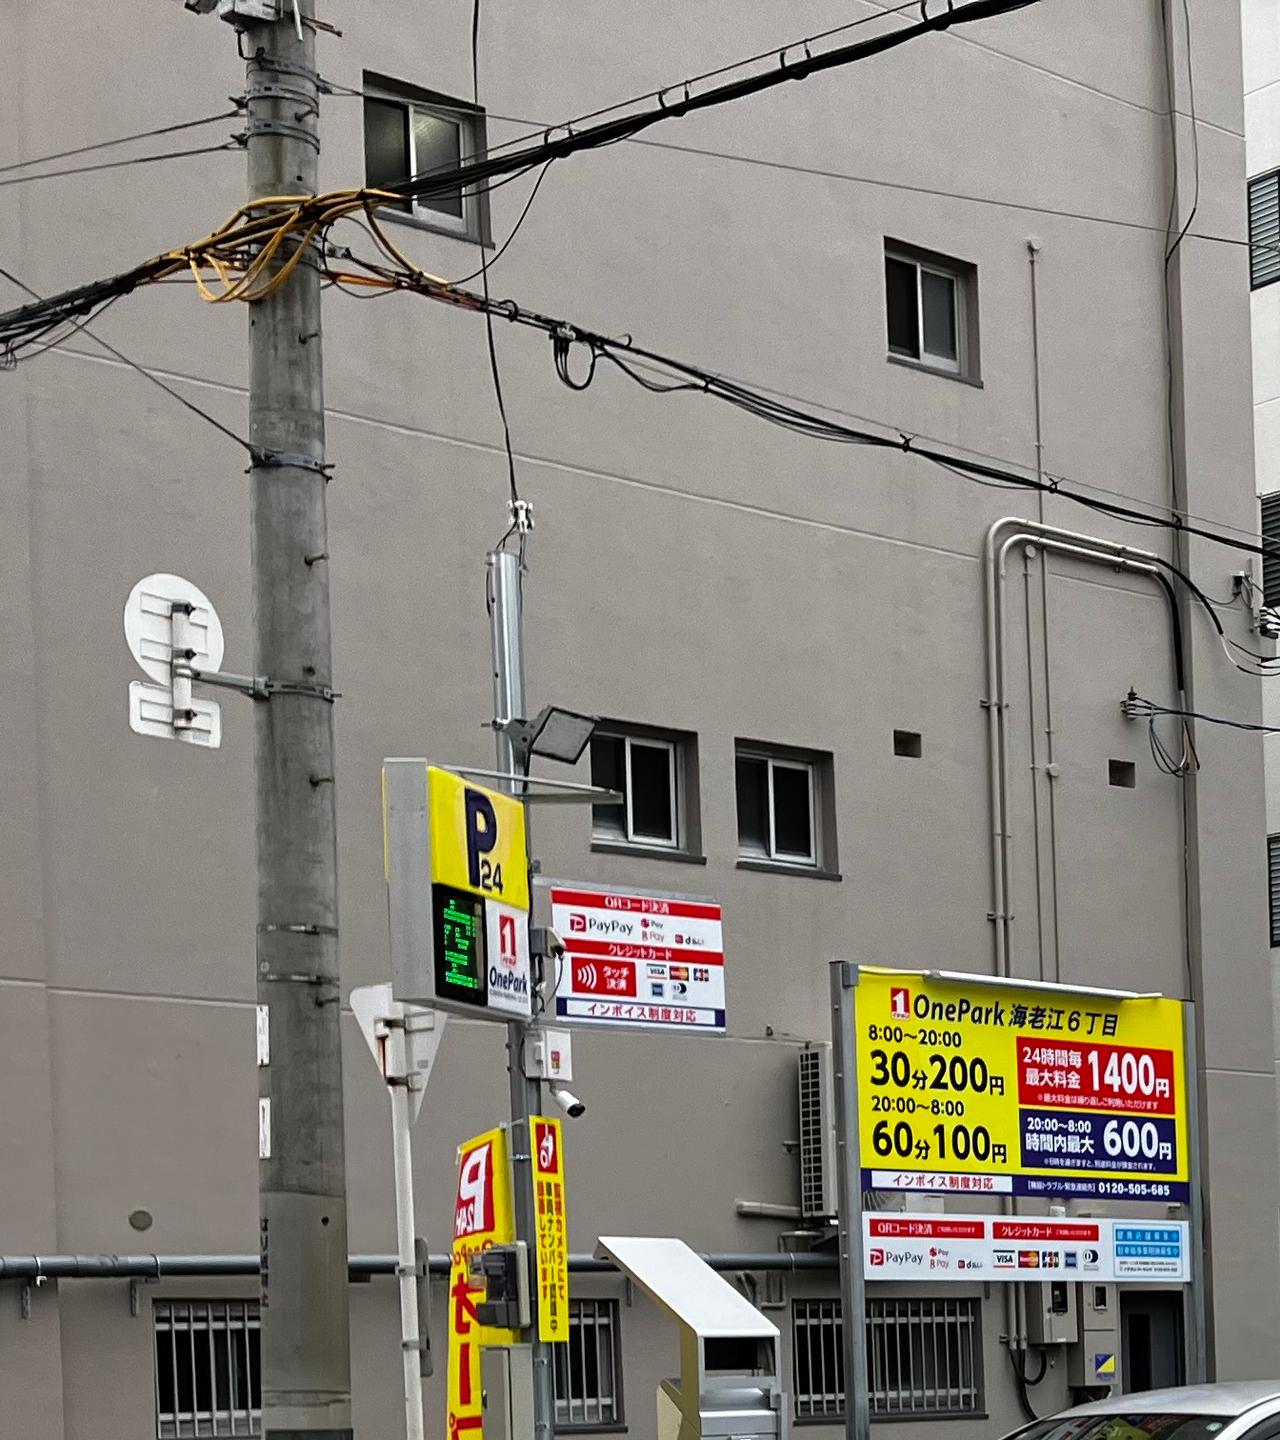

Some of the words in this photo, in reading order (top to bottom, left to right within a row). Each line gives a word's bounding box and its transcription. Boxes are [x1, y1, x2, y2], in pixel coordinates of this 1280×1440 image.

[465, 787, 498, 888] P
[480, 859, 503, 895] 24
[589, 918, 634, 936] PayPay
[608, 944, 673, 960] クレジットカード
[489, 966, 528, 995] OnePark
[603, 966, 630, 978] タッチ
[650, 968, 665, 976] VISA
[606, 977, 628, 991] 決済
[587, 1003, 697, 1022] インボイス制度対応
[913, 994, 1005, 1026] OnePark
[1008, 1003, 1119, 1037] 海老江6丁目
[1022, 1046, 1083, 1069] 24時間毎
[1025, 1067, 1082, 1090] 最大料金
[1087, 1049, 1170, 1099] 1400円
[1025, 1132, 1095, 1155] 時間内最大
[1103, 1119, 1172, 1160] 600円
[893, 1174, 994, 1191] インボイス制度対応
[1098, 1181, 1170, 1197] 0120-505-685
[877, 1222, 933, 1235] QRコード決済
[1001, 1225, 1052, 1239] クレジットカード
[886, 1251, 924, 1266] PayPay
[996, 1255, 1013, 1264] VISA
